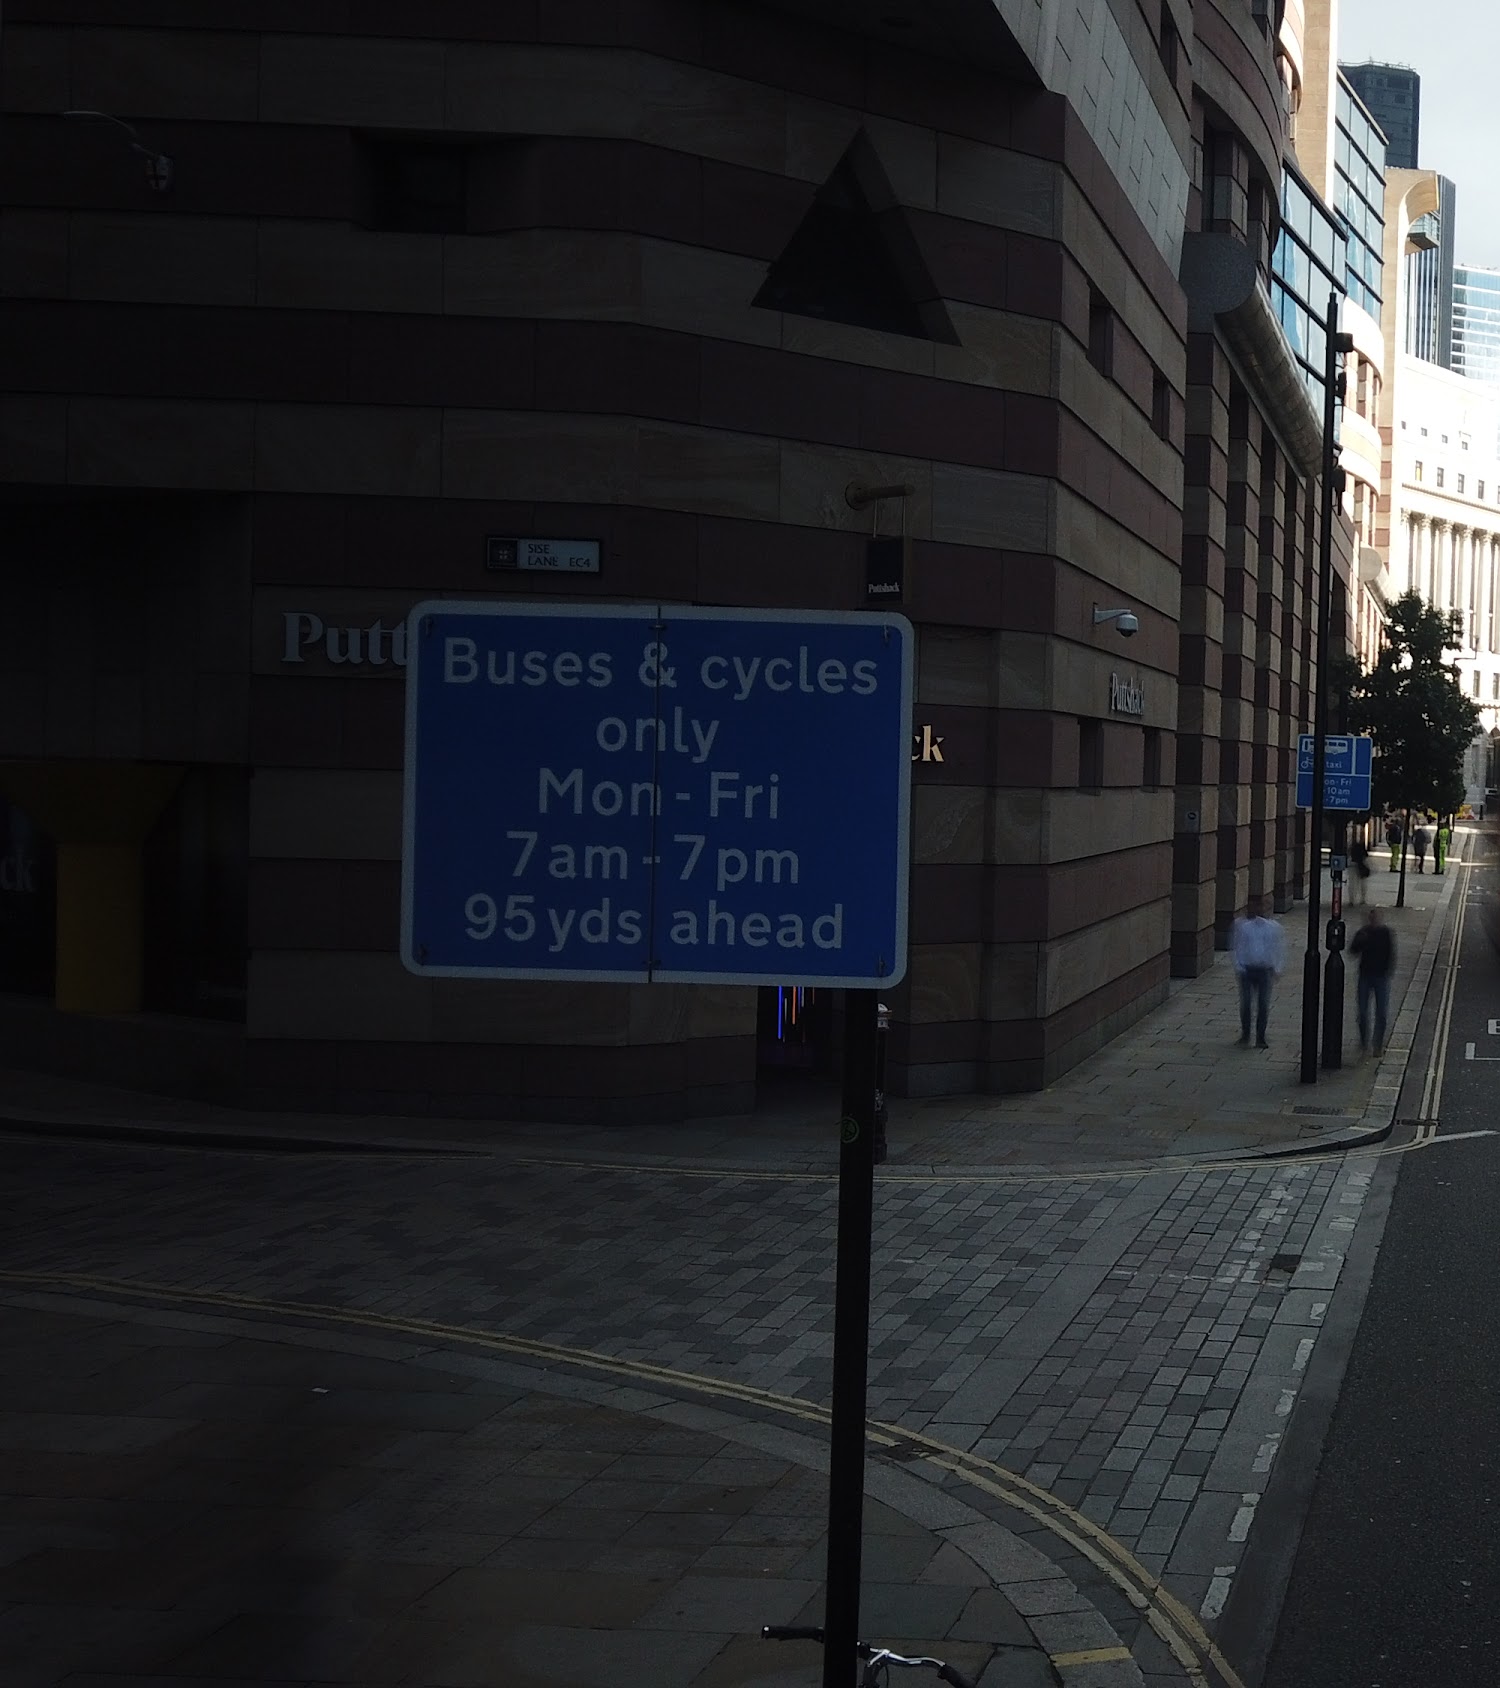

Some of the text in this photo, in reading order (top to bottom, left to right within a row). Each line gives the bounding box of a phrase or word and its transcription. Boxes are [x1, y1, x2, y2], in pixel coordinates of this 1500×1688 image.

[527, 543, 551, 554] SISE
[528, 556, 591, 568] LANE EC4
[443, 636, 879, 701] Buses & cycles
[596, 705, 720, 764] only
[1326, 761, 1342, 769] taxi
[537, 767, 662, 817] Mon
[709, 770, 780, 819] Fri
[1324, 778, 1335, 786] on
[669, 900, 844, 949] ahead
